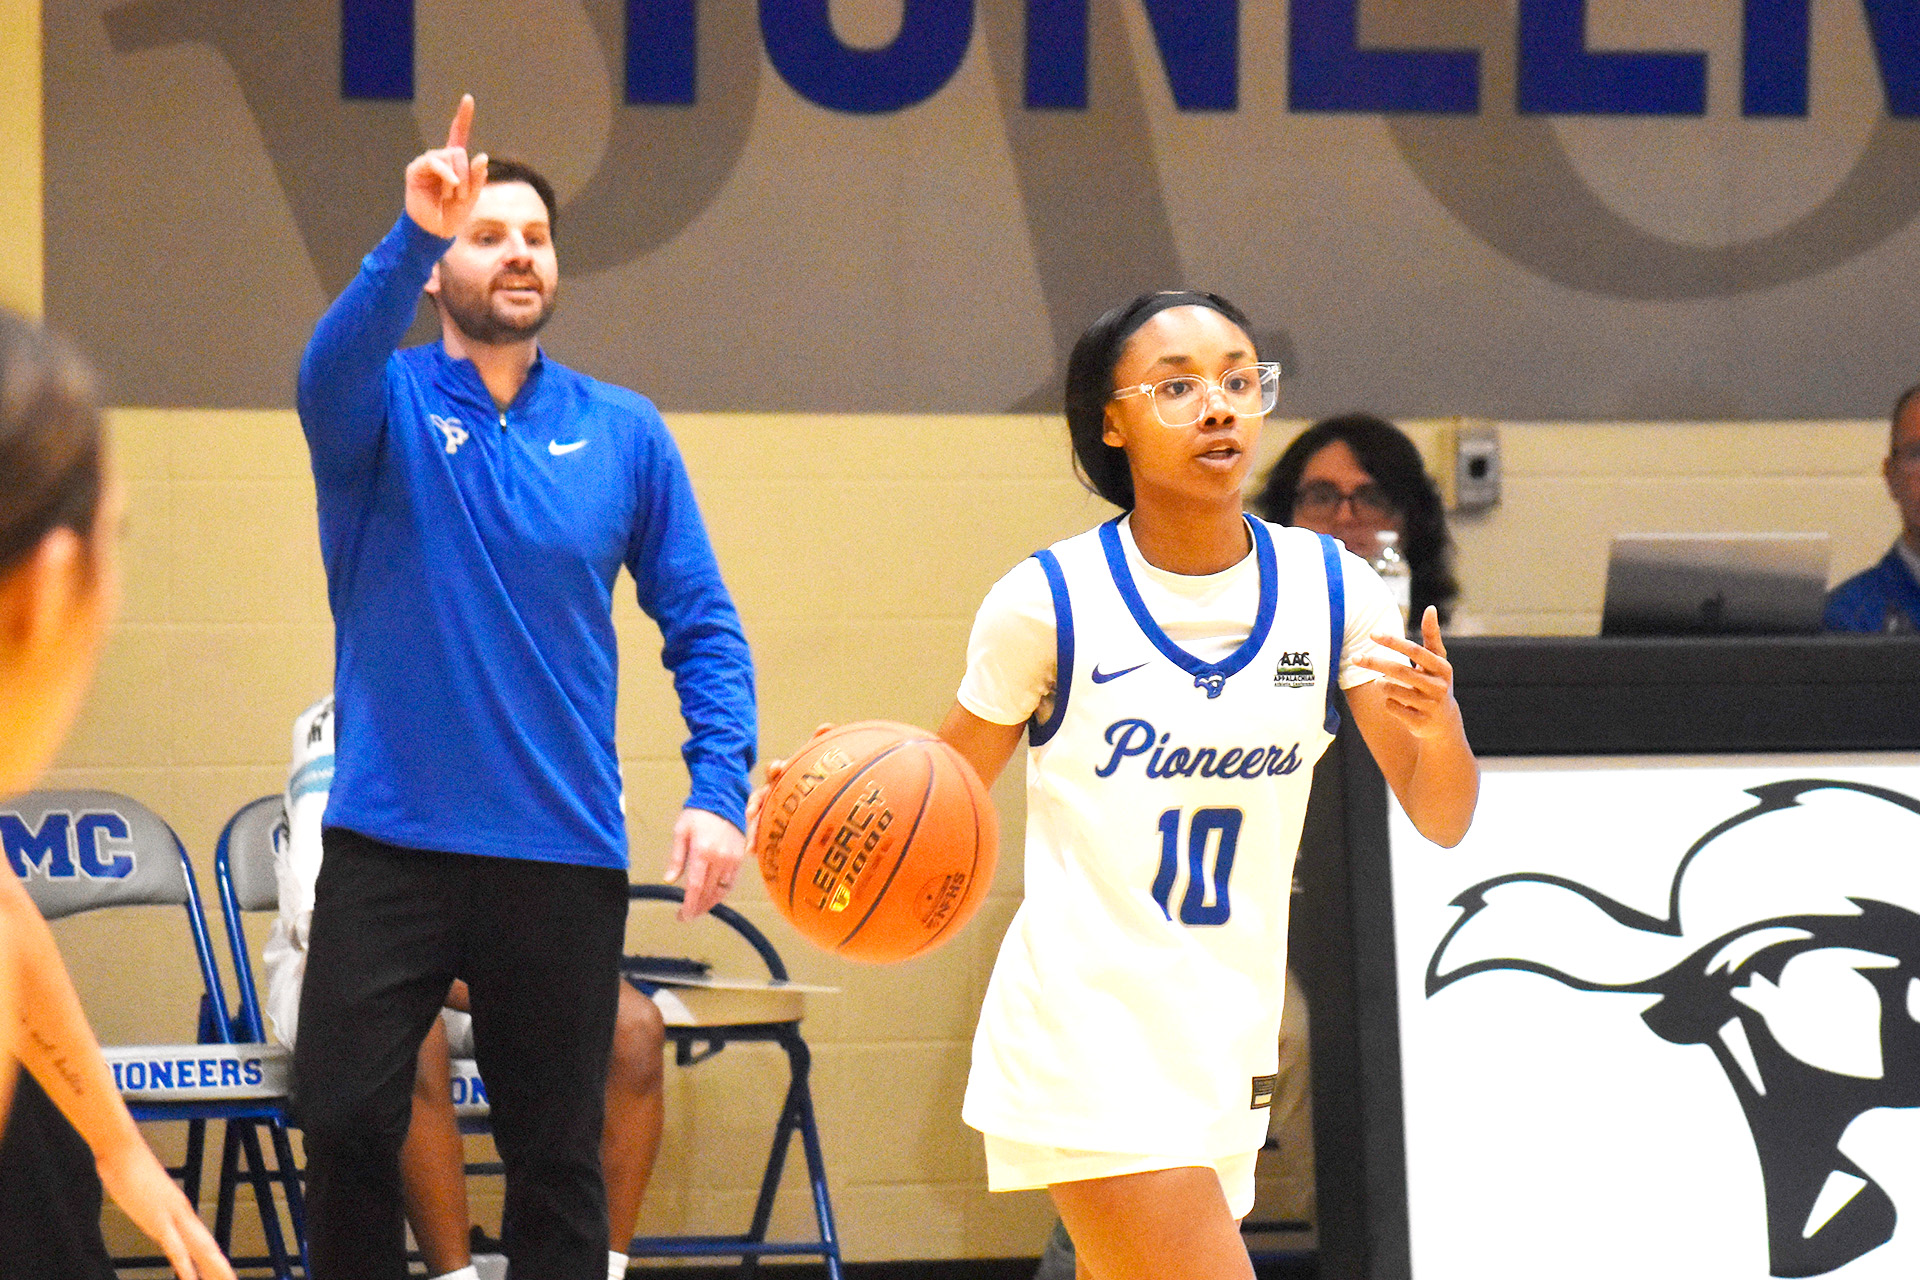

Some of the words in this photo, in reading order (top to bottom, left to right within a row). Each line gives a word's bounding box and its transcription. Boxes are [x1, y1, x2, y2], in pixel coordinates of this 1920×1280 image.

[1280, 651, 1310, 666] AAC
[1095, 718, 1302, 779] Pioneers
[804, 780, 886, 911] LEGACY
[843, 808, 894, 886] 1000
[1149, 805, 1246, 928] 10
[111, 1056, 264, 1092] IONEERS
